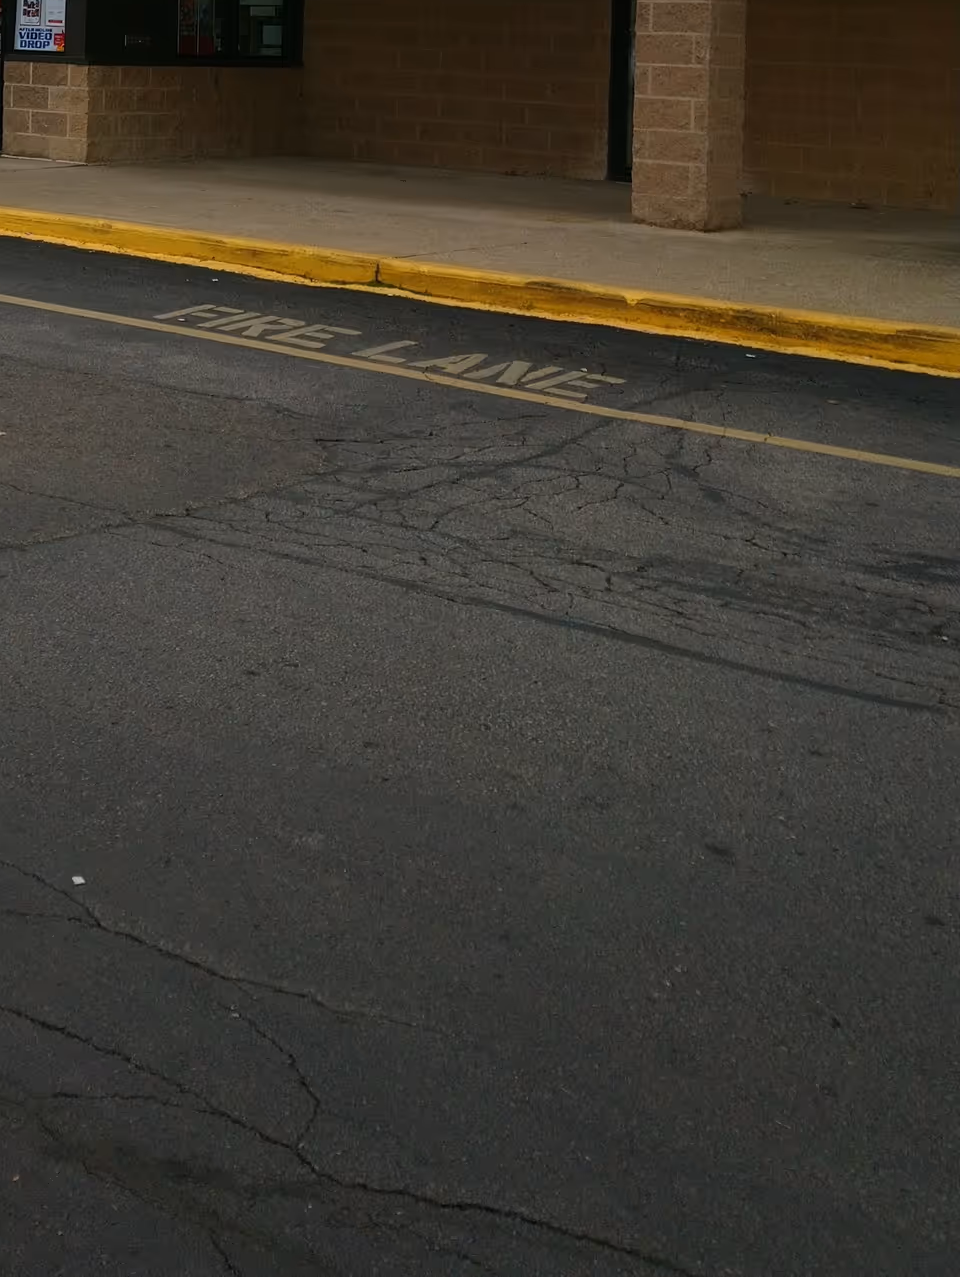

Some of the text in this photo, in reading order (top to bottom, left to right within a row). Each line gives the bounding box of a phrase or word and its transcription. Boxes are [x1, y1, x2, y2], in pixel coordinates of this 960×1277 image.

[19, 32, 52, 41] VIDEO
[20, 40, 50, 49] DROP
[154, 303, 626, 401] FIRE LANE
